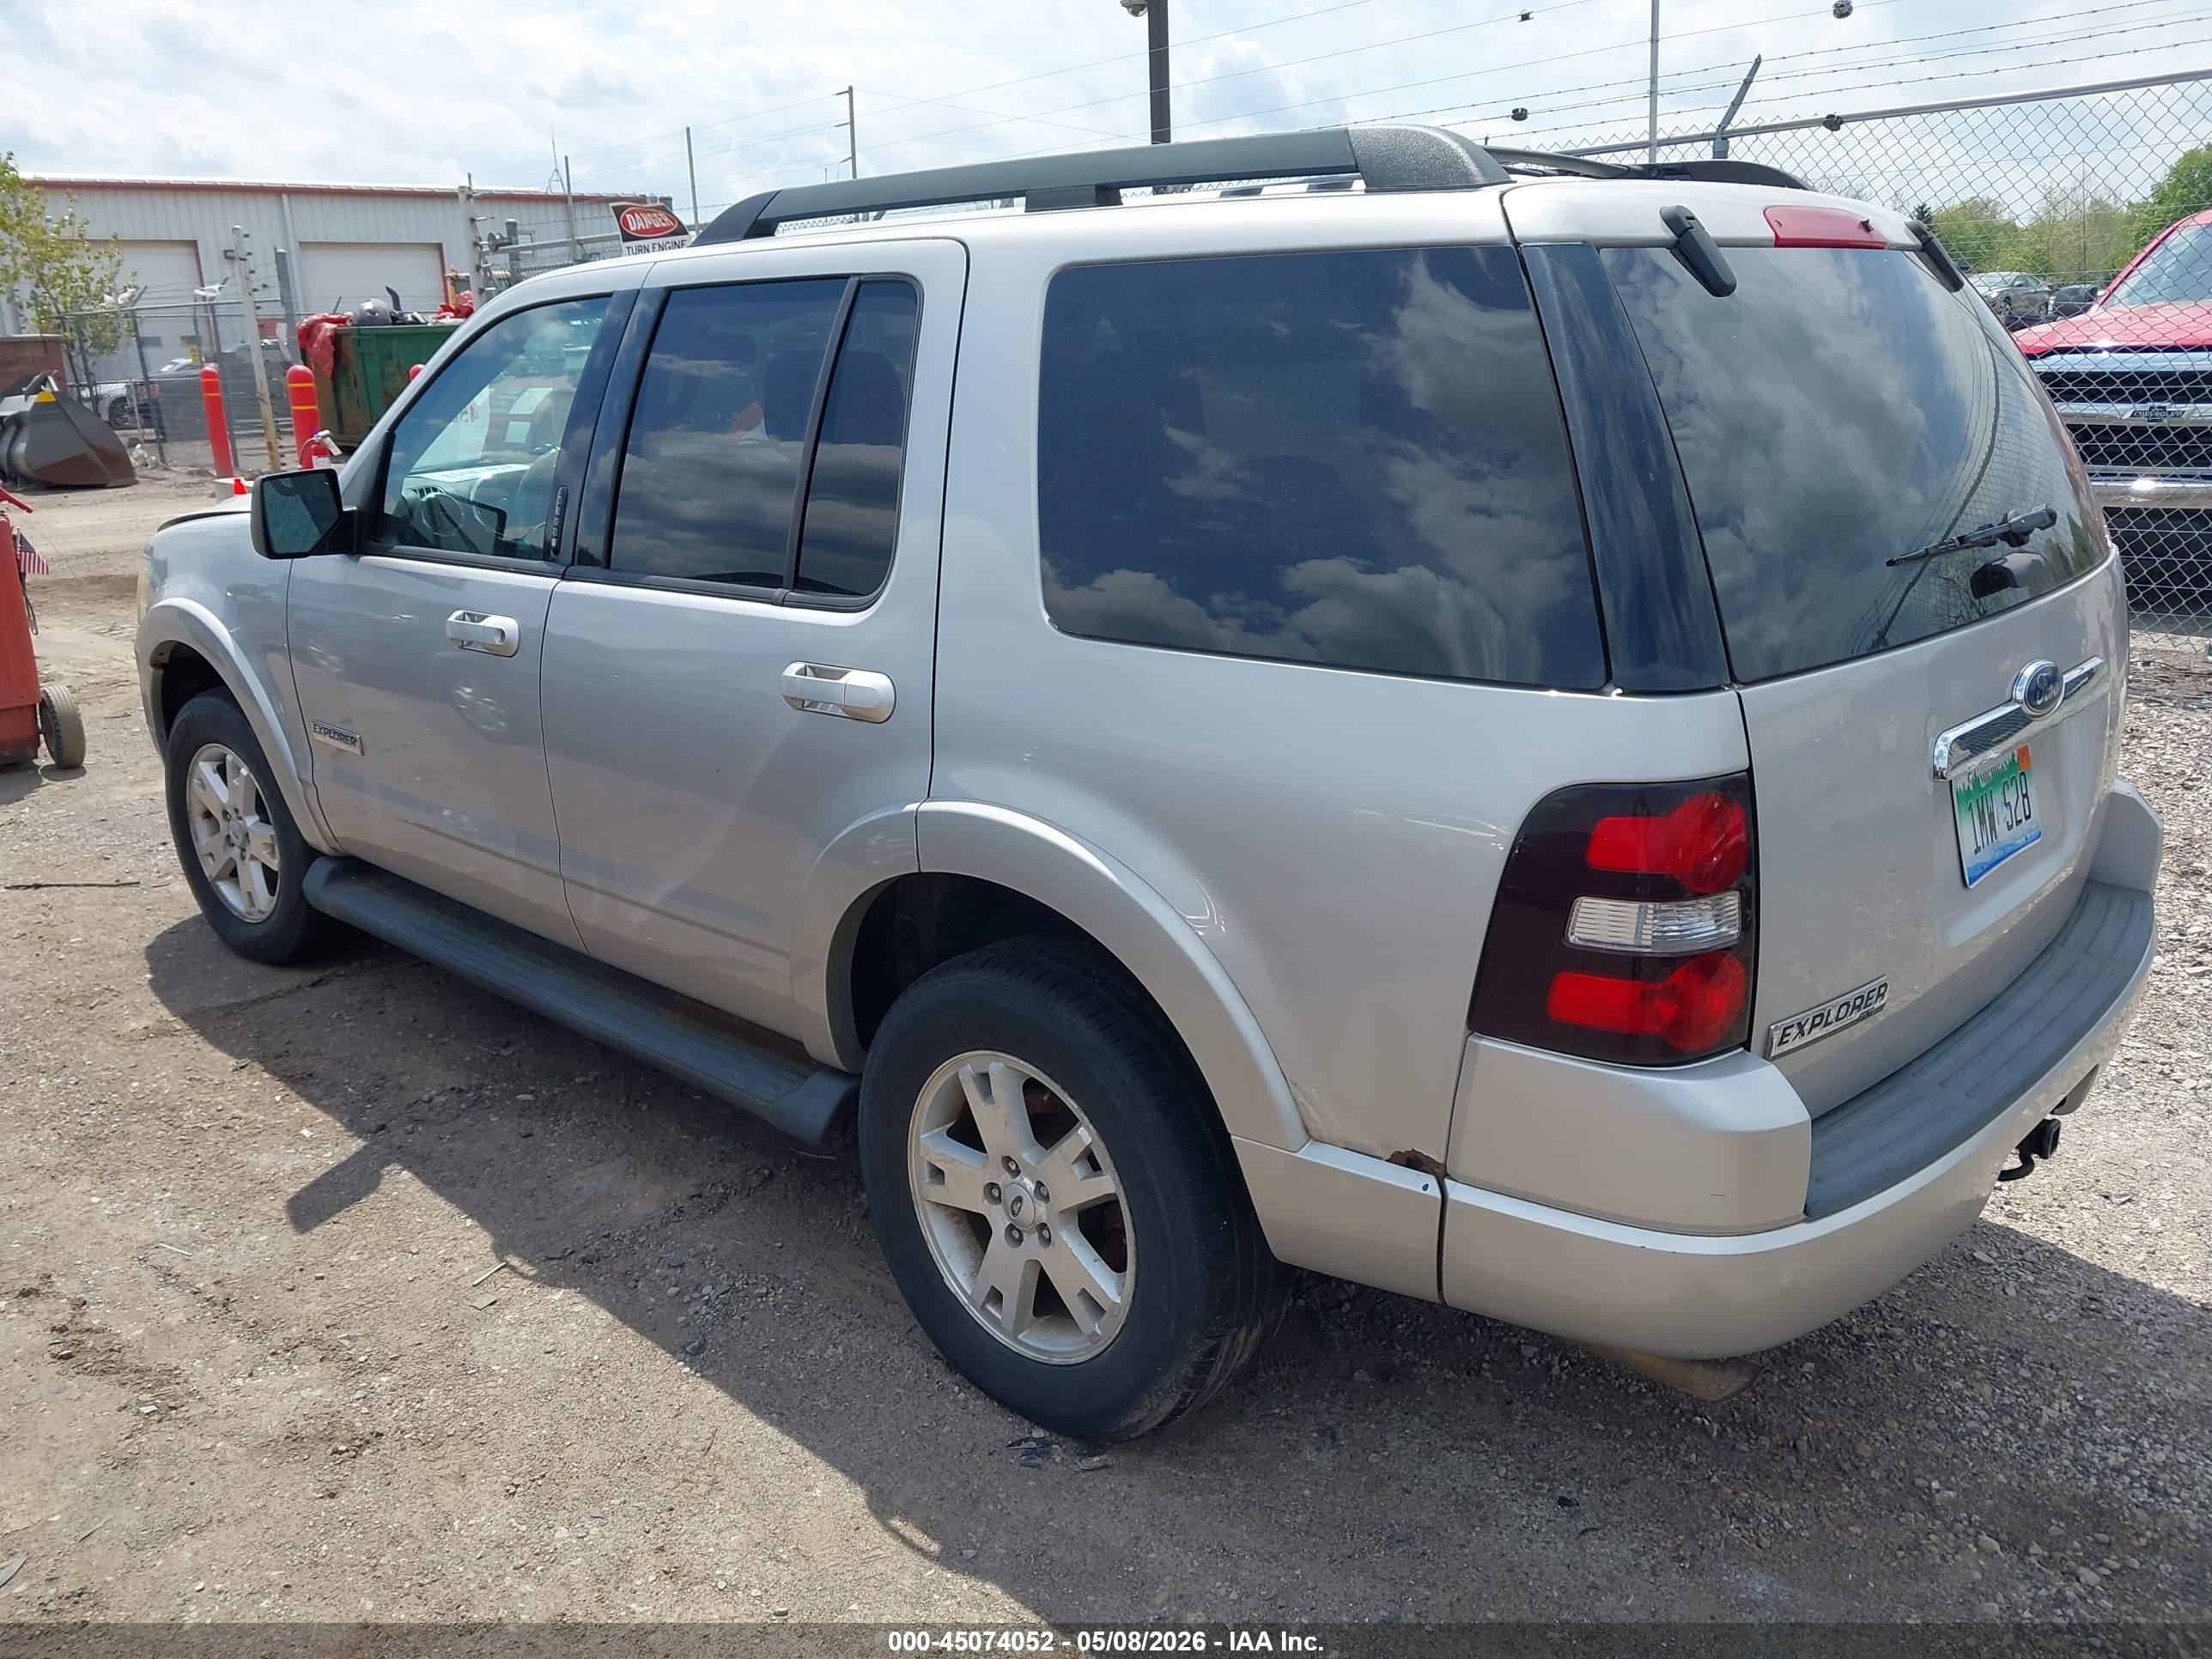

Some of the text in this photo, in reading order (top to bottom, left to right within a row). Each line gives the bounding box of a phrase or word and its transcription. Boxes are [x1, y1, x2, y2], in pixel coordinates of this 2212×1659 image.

[625, 212, 674, 231] DANGER
[626, 240, 687, 256] TURN ENGINE
[2035, 672, 2059, 705] Ford
[313, 723, 357, 746] EXPLORER
[1978, 759, 2009, 783] MICHIGAN
[1968, 789, 1998, 855] 1MW
[1778, 981, 1888, 1047] EXPLORER
